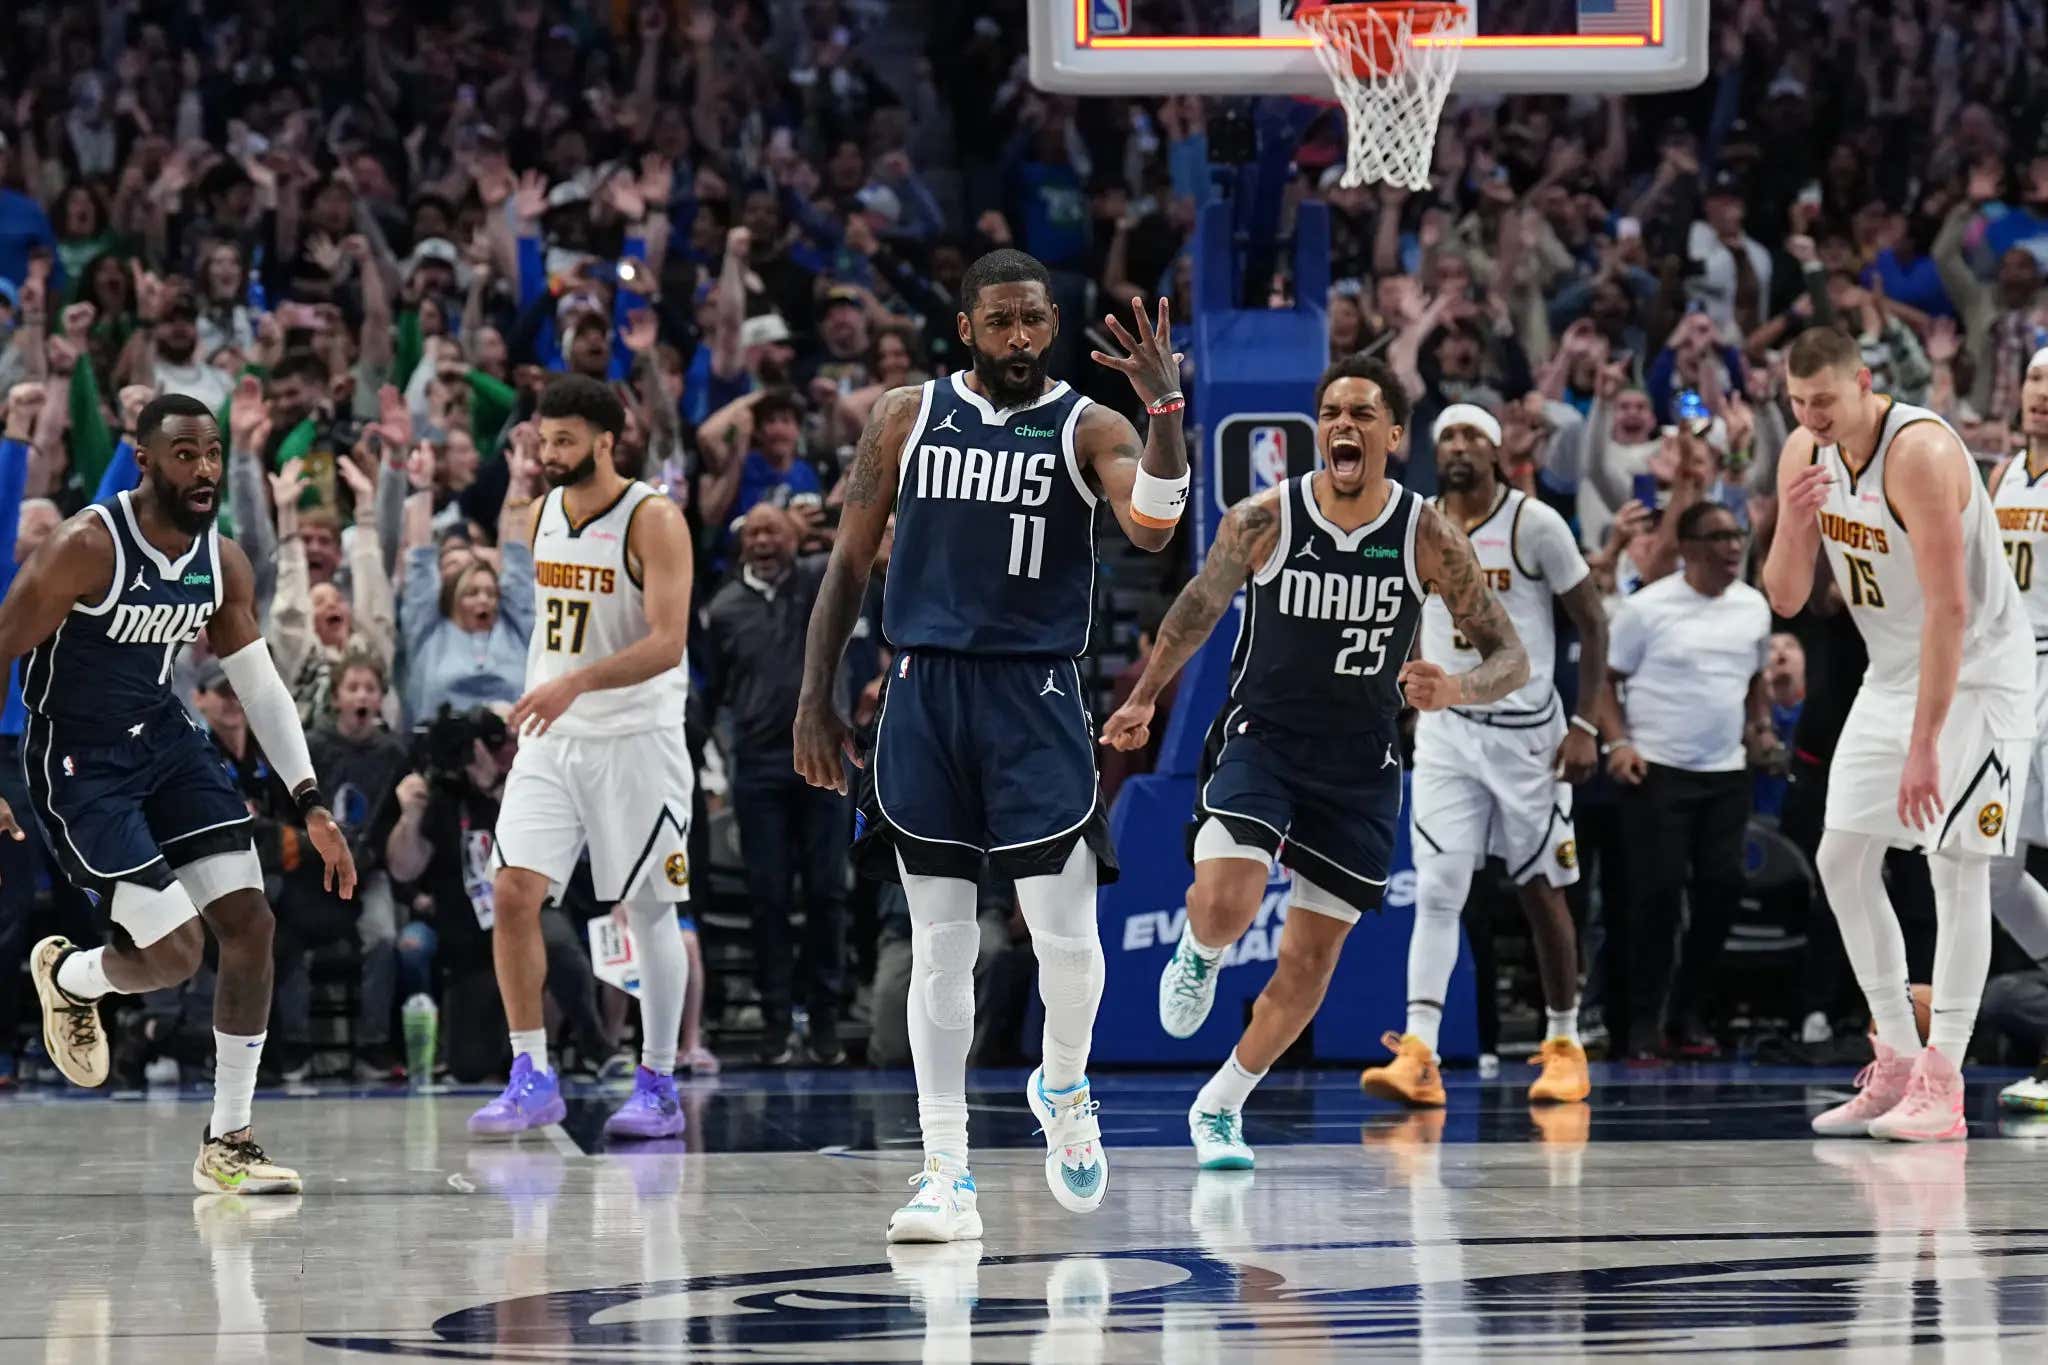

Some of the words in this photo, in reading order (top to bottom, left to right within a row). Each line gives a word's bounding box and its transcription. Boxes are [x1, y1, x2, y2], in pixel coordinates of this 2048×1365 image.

[1014, 423, 1055, 438] chime
[917, 445, 1056, 506] MAVS
[1008, 513, 1046, 580] 11
[1363, 545, 1399, 559] chime
[183, 572, 211, 585] chime
[1279, 568, 1404, 623] MAVS
[1843, 552, 1886, 608] 15
[106, 602, 214, 643] MAVS
[545, 597, 592, 655] 27
[1334, 628, 1394, 676] 25
